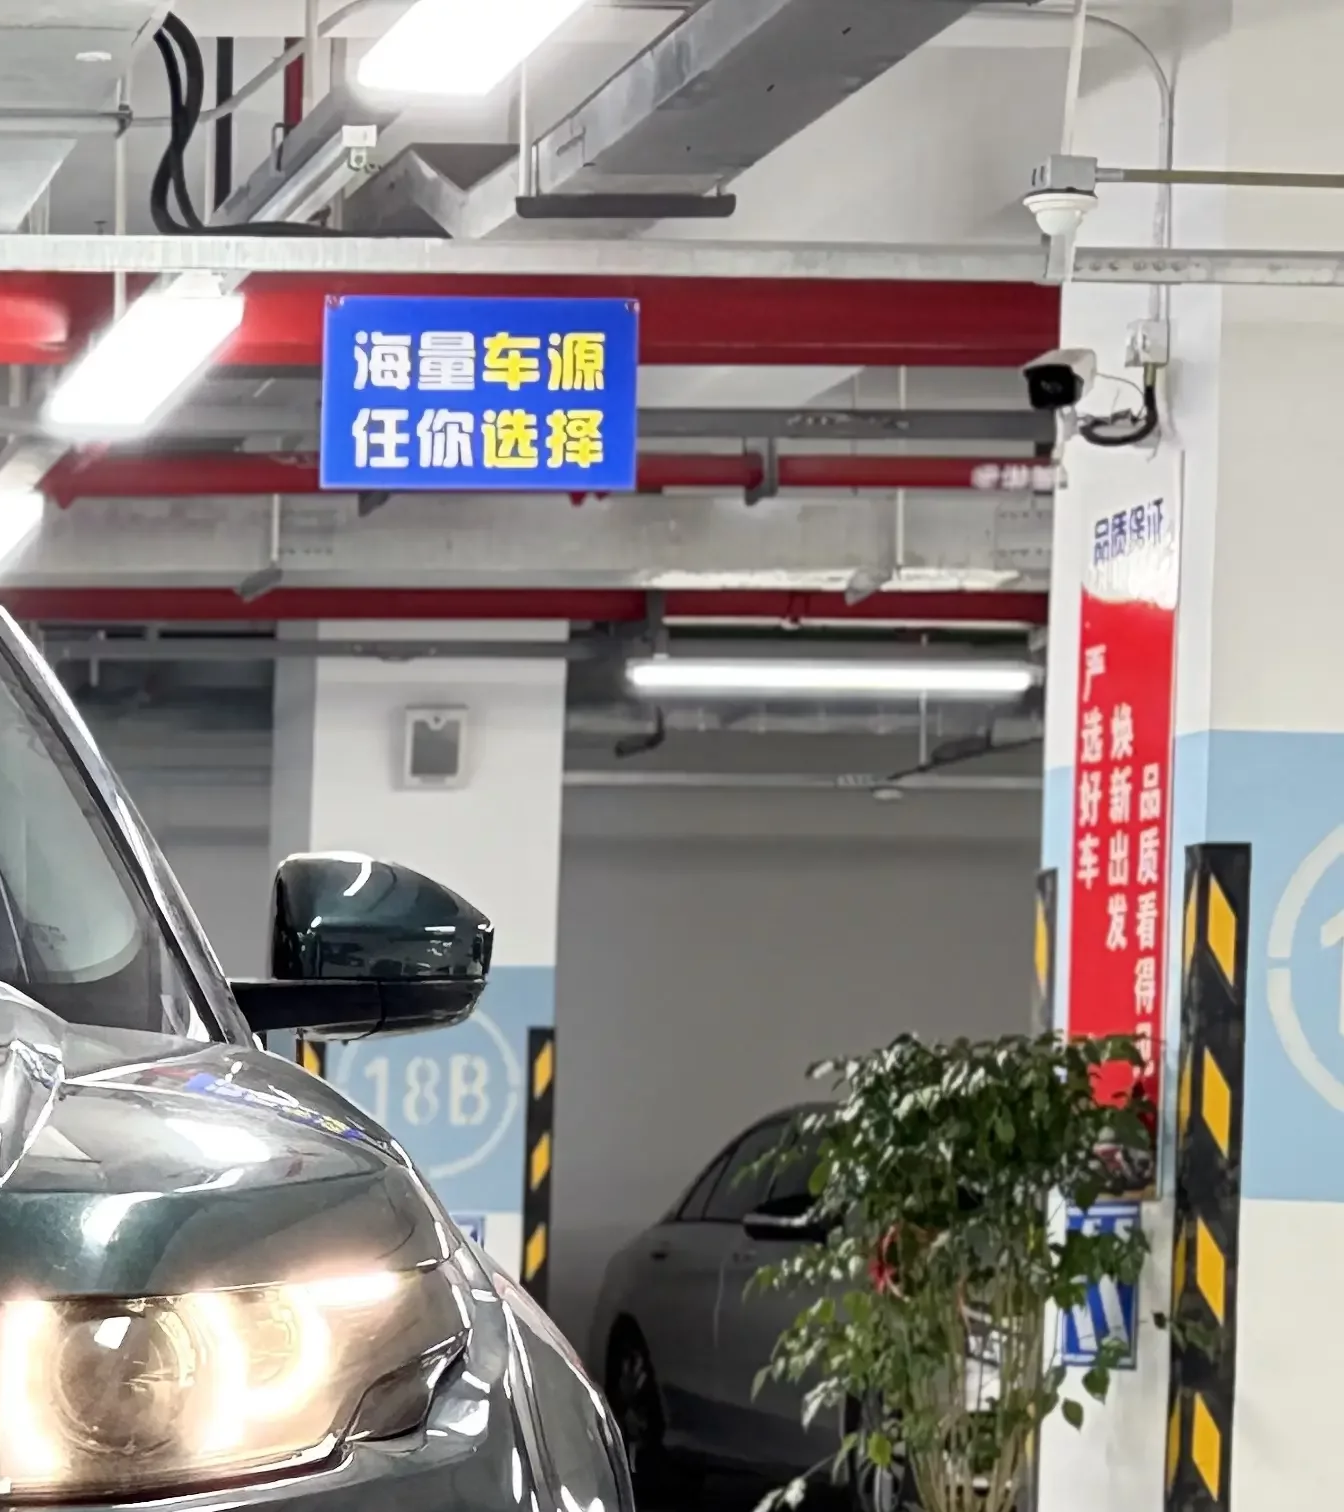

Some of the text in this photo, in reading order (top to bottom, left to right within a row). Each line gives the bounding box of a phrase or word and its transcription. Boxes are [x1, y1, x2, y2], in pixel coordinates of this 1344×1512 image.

[353, 331, 606, 392] 海量车源
[351, 407, 605, 469] 任你选择
[1093, 497, 1164, 566] 品质保证
[1076, 643, 1107, 890] 严选好车
[1105, 702, 1135, 951] 焕新出发
[364, 1053, 489, 1128] 18B
